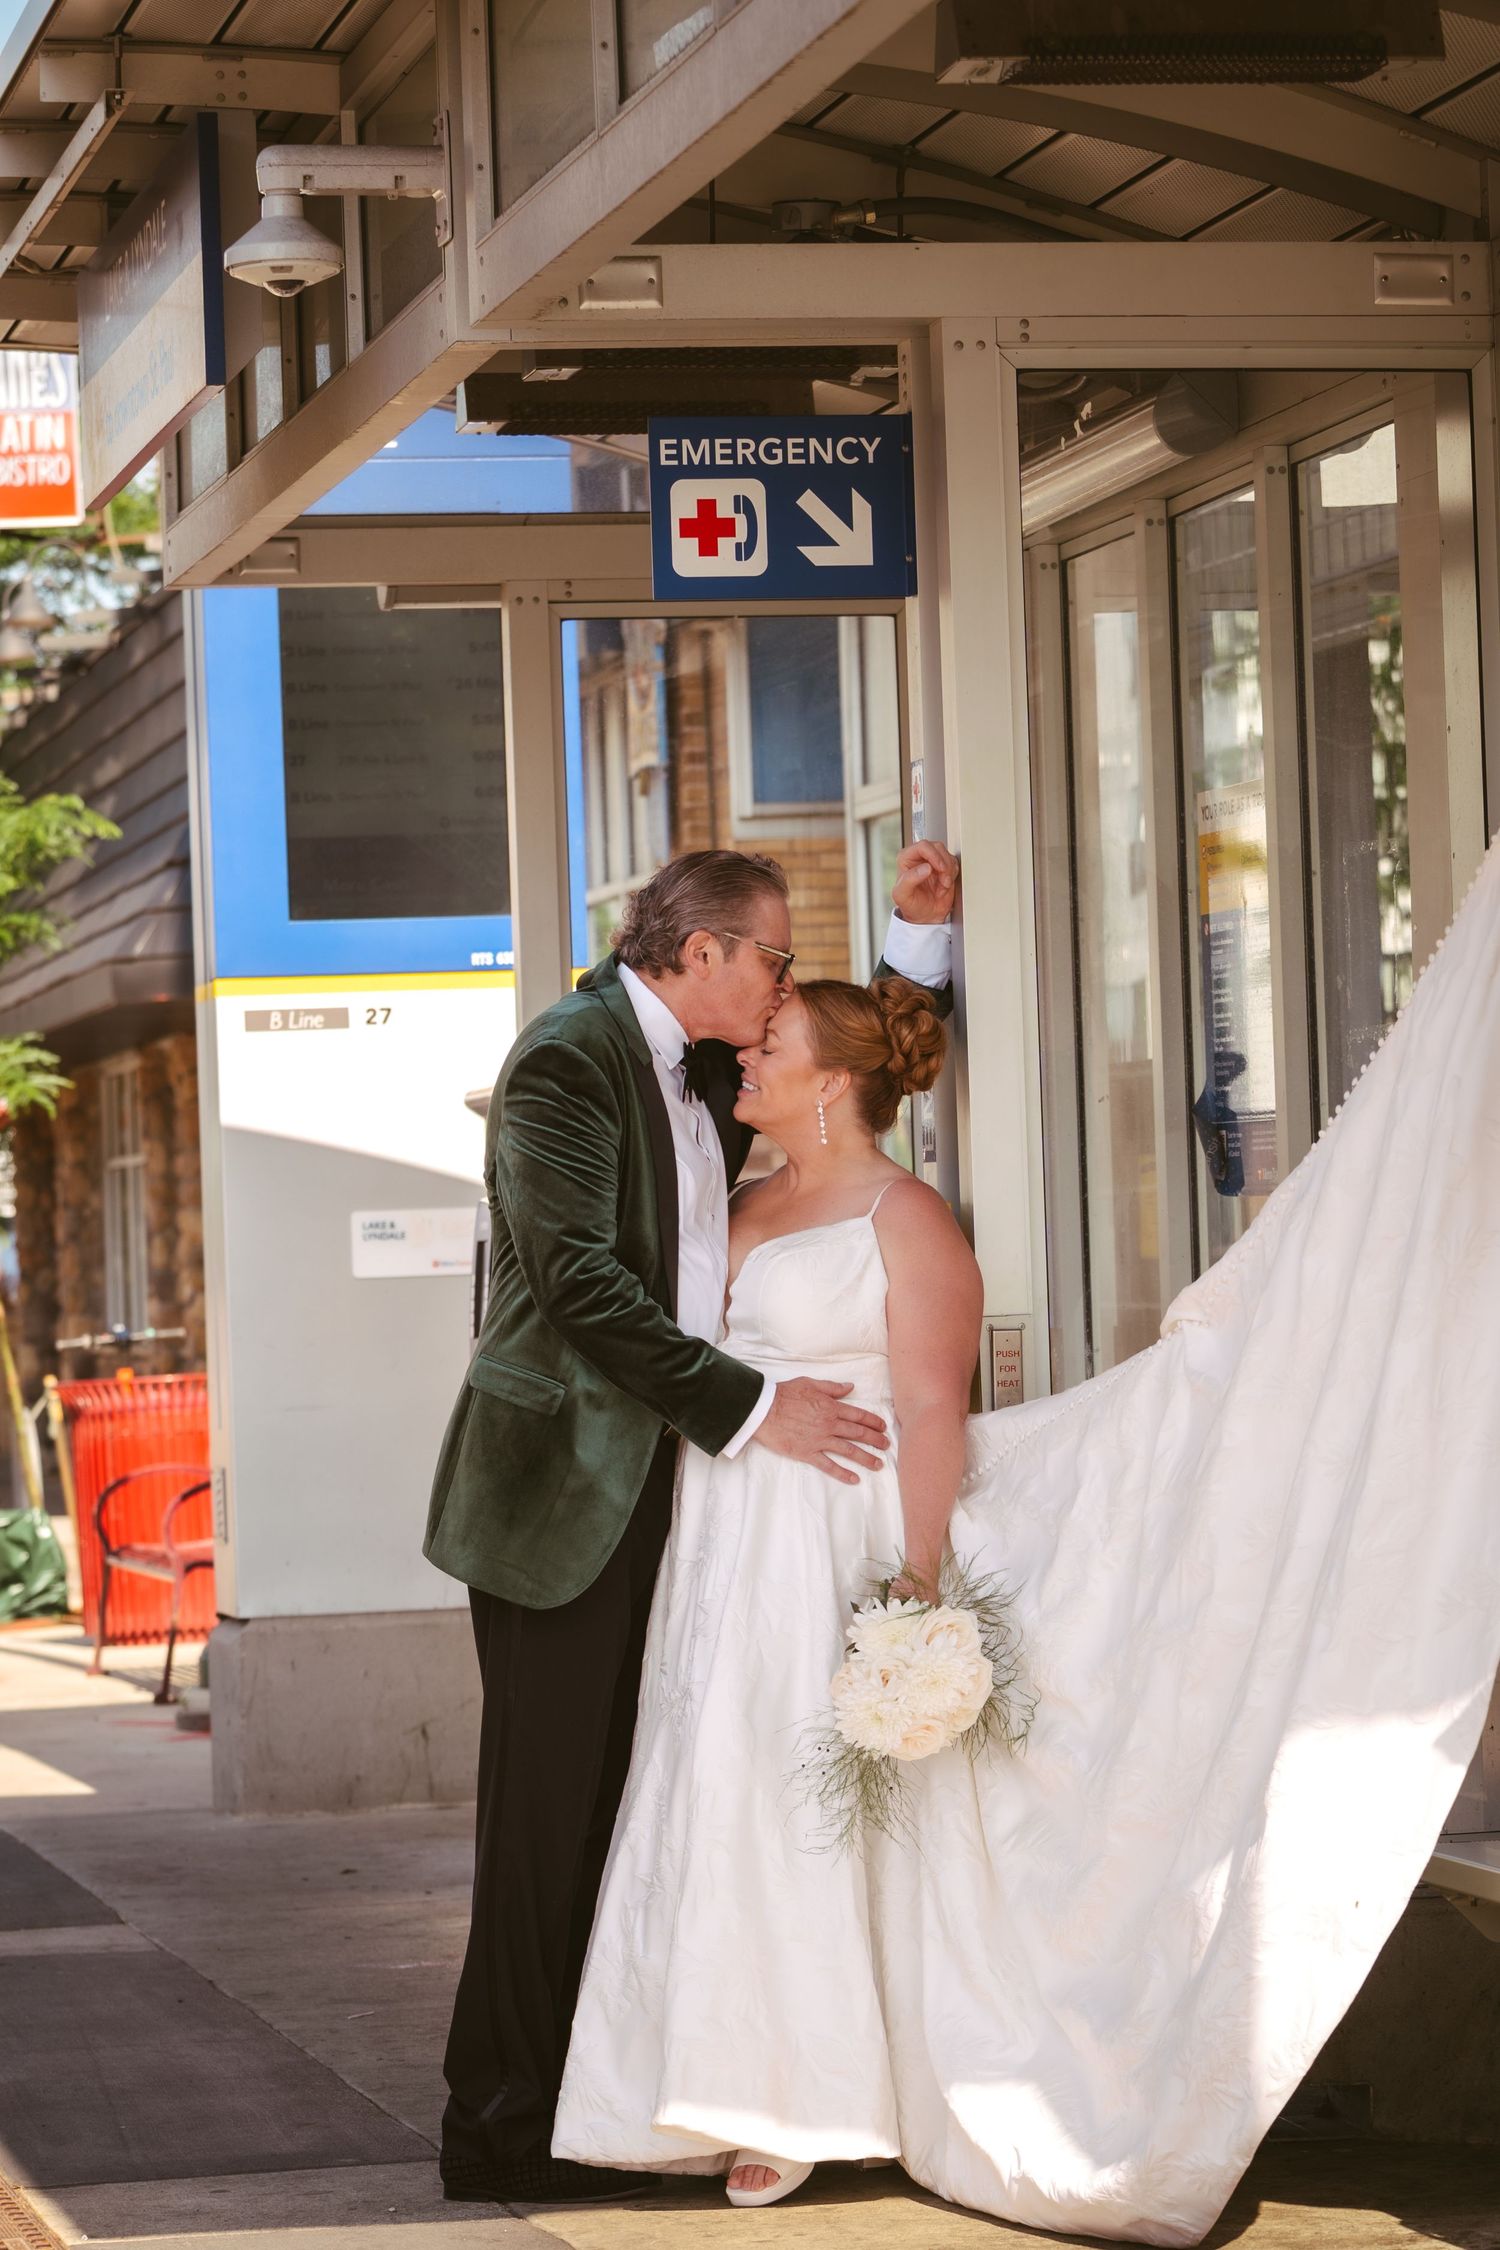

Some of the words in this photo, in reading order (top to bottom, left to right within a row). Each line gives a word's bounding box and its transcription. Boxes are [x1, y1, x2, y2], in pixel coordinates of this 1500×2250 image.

[0, 413, 67, 454] ATIN
[659, 437, 882, 466] EMERGENCY
[270, 1011, 283, 1030] B
[288, 1011, 325, 1029] Line
[365, 1008, 392, 1025] 27
[362, 1231, 407, 1243] LYNDALE
[996, 1350, 1020, 1358] PUSH
[999, 1365, 1017, 1373] FOR
